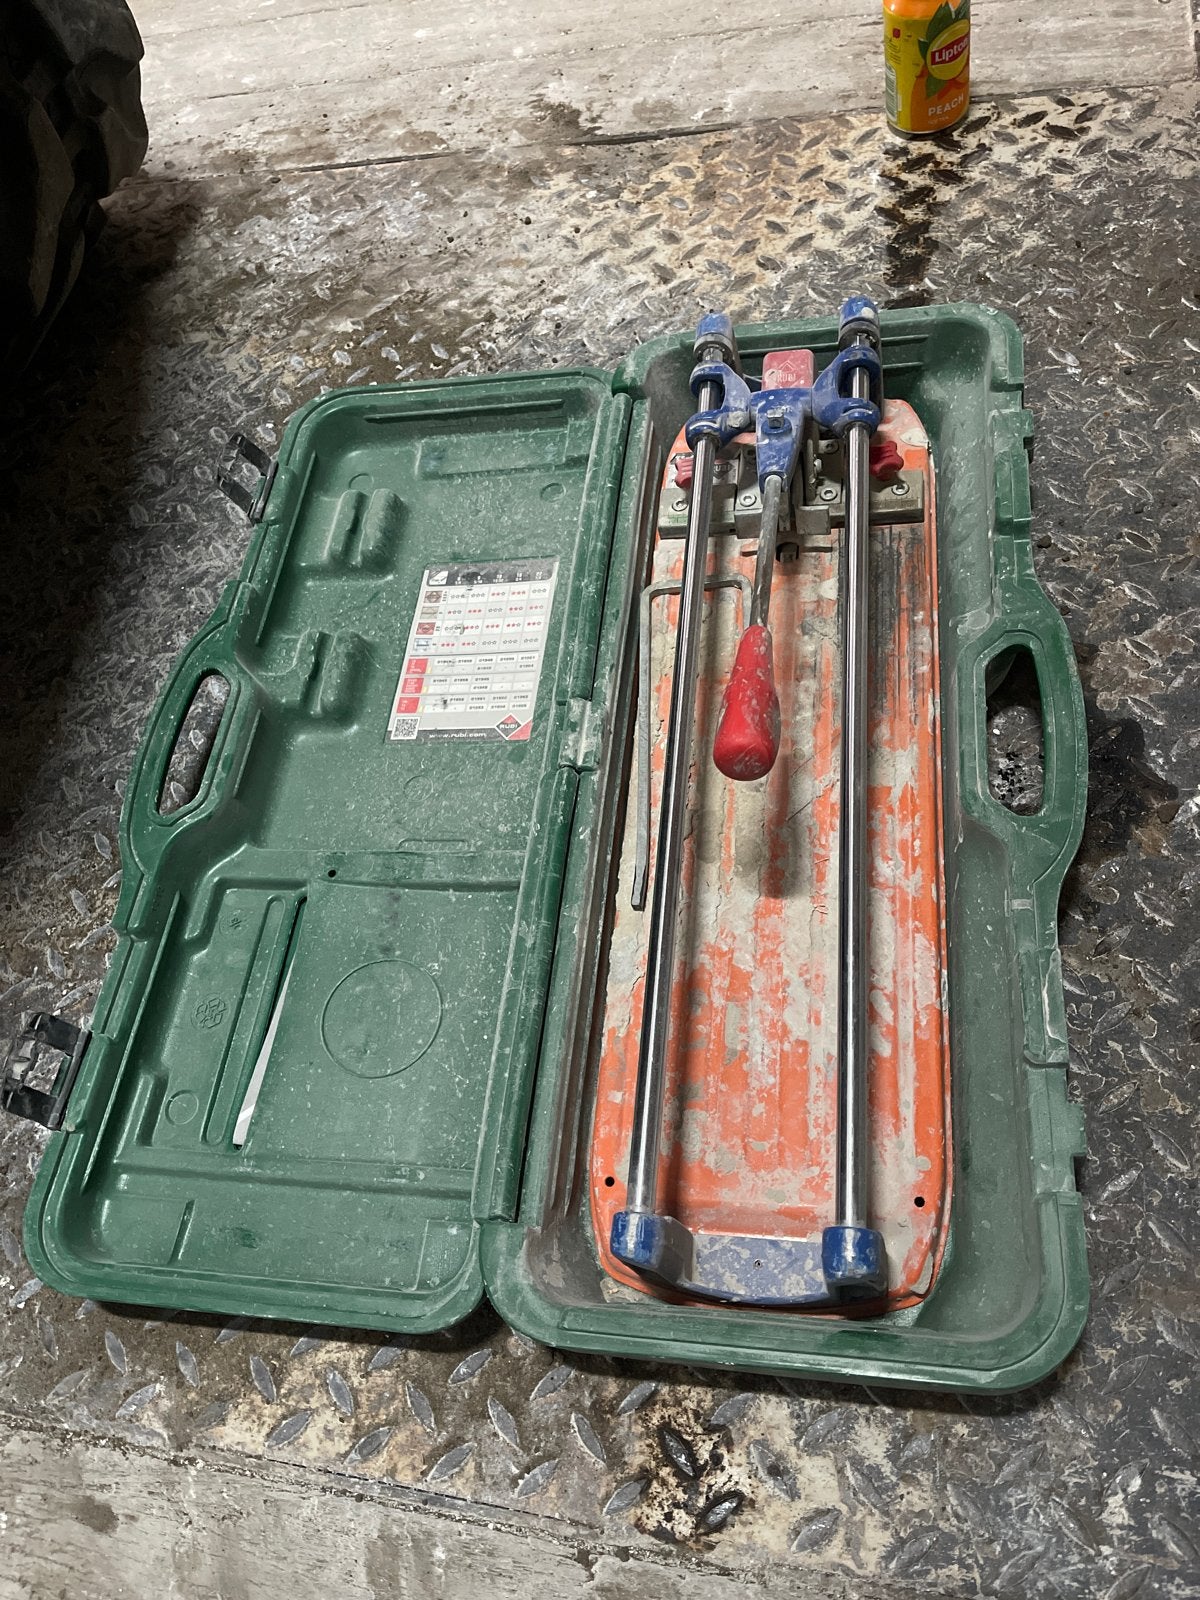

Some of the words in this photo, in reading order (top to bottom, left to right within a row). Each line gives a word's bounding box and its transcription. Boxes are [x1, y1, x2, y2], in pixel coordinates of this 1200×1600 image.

[934, 37, 970, 63] Lipton
[928, 93, 965, 117] PEACH
[777, 373, 797, 384] RUBI
